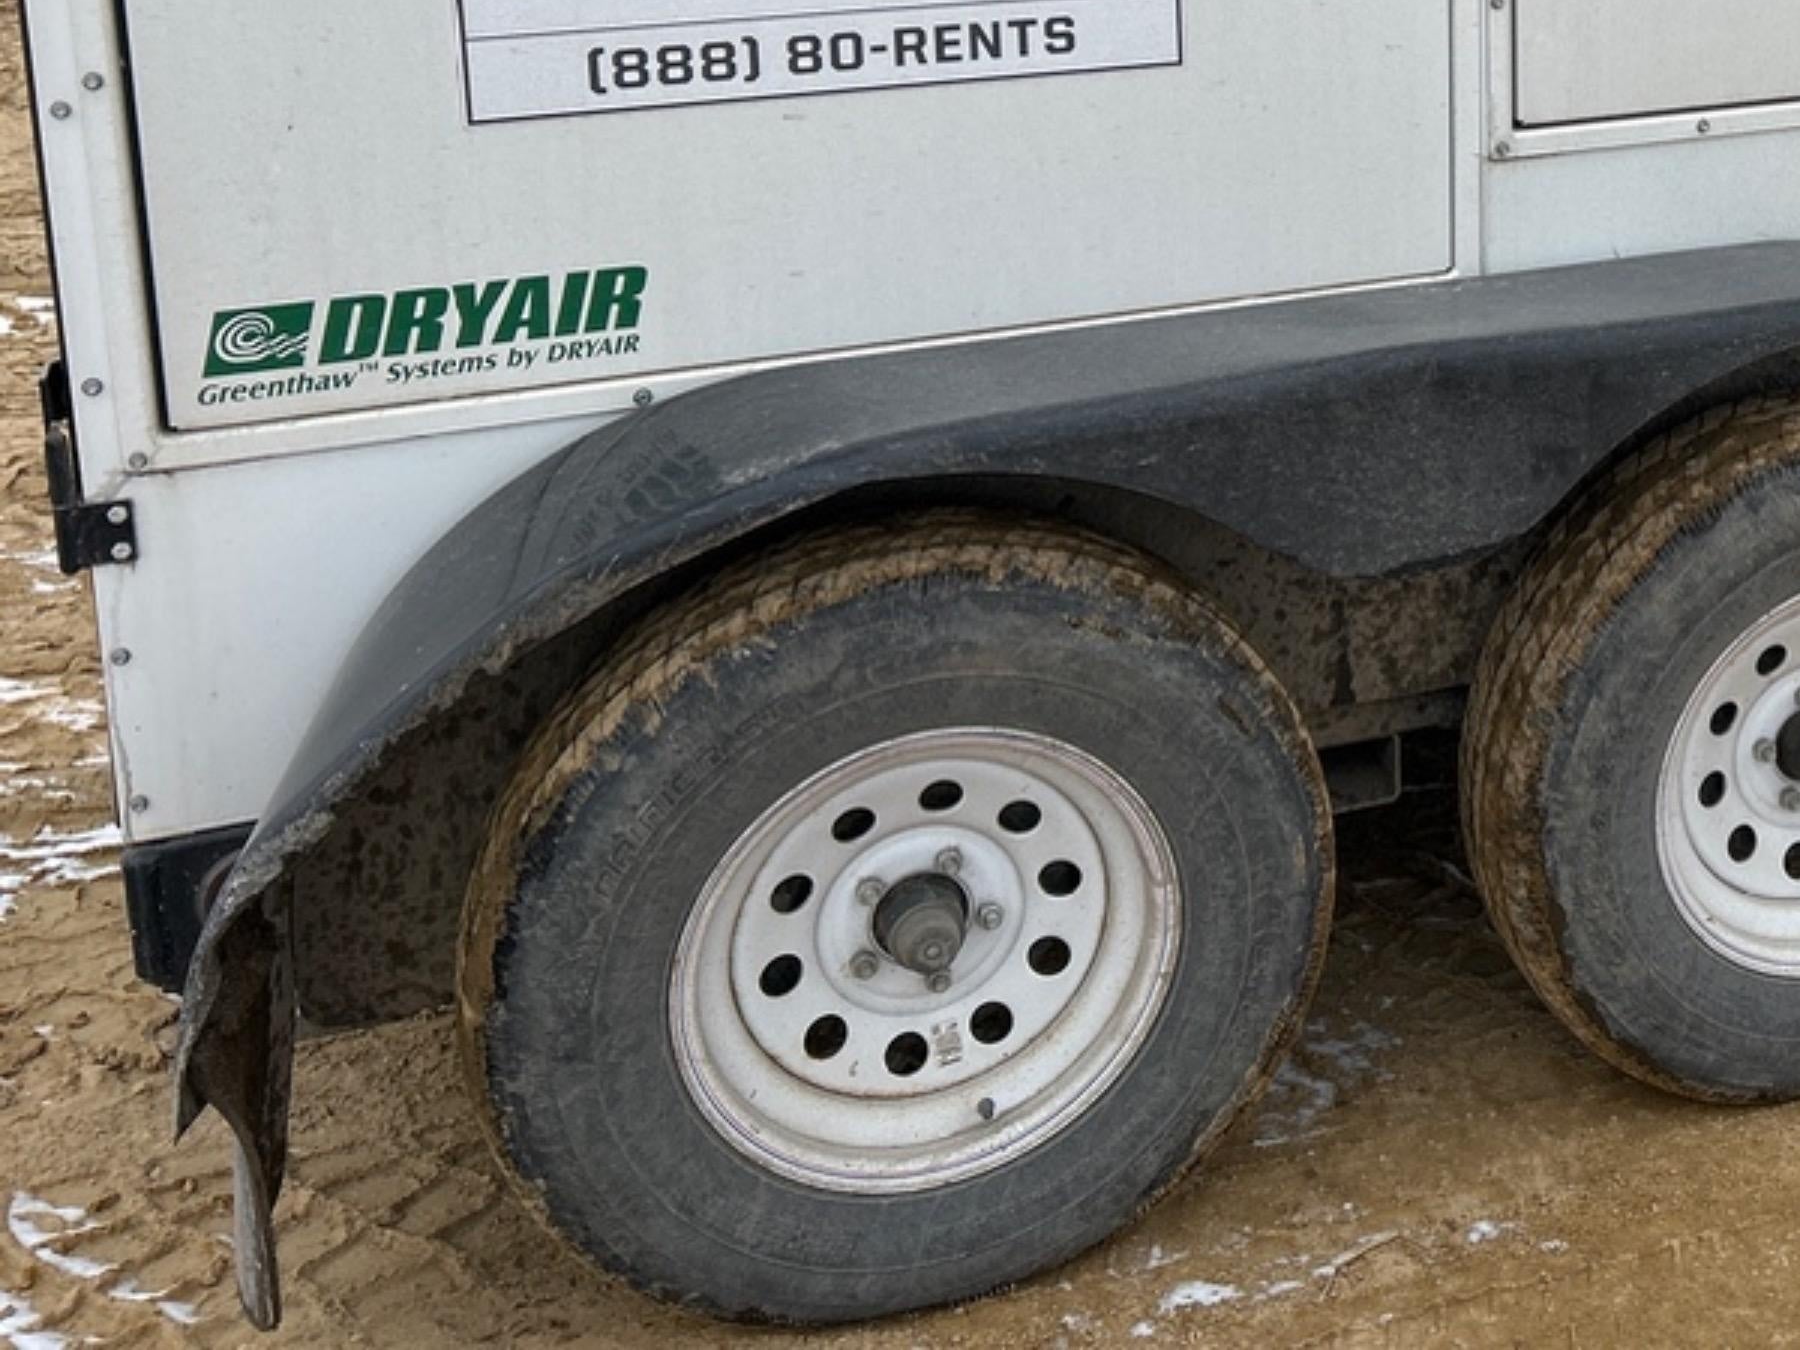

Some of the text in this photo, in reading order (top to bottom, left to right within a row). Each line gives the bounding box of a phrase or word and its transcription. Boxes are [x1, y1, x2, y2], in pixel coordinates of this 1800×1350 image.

[587, 16, 1076, 95] (888) 80-RENTS
[317, 266, 648, 366] DRYAIR
[385, 355, 497, 384] Systems
[507, 347, 538, 369] by
[547, 335, 640, 363] DRYAIR
